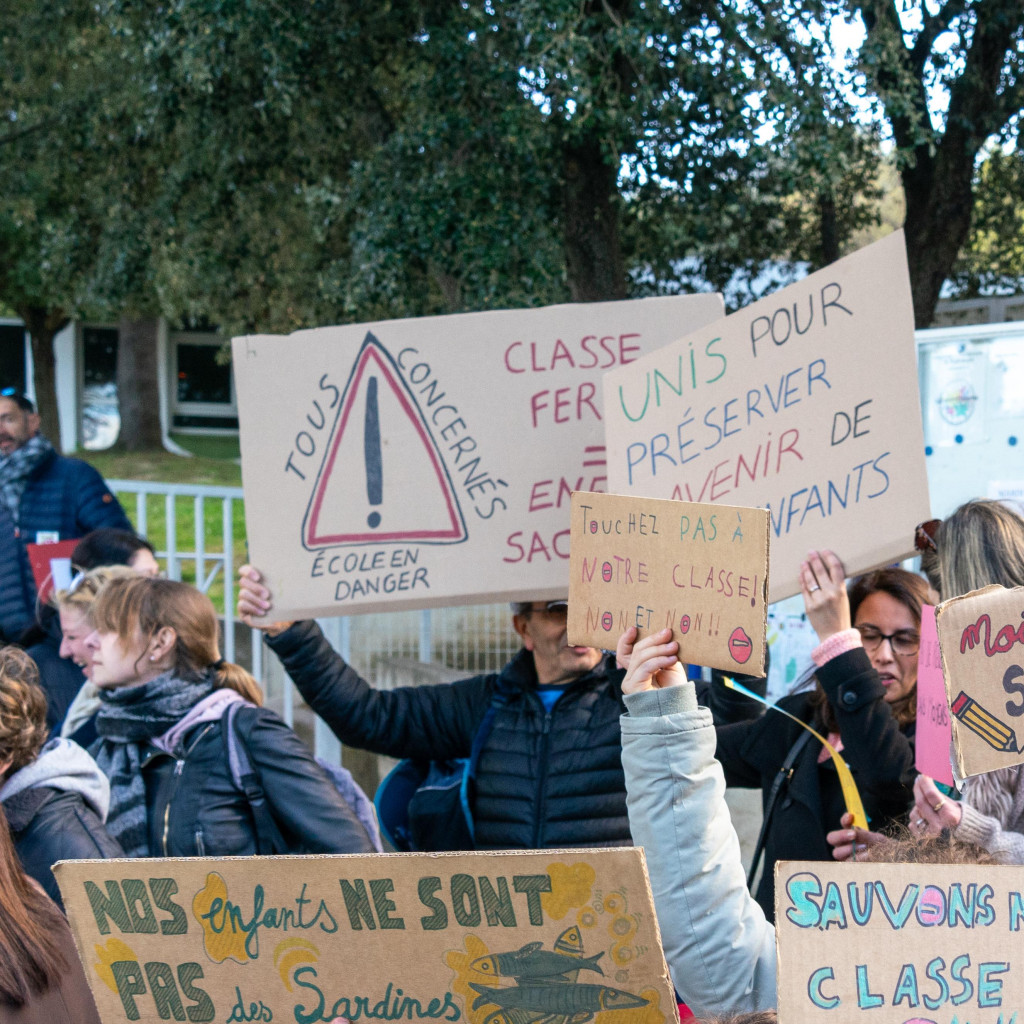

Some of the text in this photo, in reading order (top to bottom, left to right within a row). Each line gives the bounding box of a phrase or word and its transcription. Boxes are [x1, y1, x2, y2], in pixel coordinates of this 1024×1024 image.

[504, 333, 642, 374] CLASSE
[619, 282, 853, 422] UNIS POUR
[284, 373, 340, 481] TOUS
[397, 347, 509, 519] CONCERNÉS
[626, 358, 831, 486] PRÉSERVER
[831, 399, 873, 446] DE
[757, 452, 891, 538] NFANTS
[680, 515, 717, 542] PAS
[732, 512, 744, 543] À
[311, 548, 419, 578] ÉCOLE EN
[334, 567, 430, 601] DANGER
[581, 555, 757, 608] NOTRE CLASSE!
[586, 606, 629, 634] NON
[635, 605, 654, 630] ET
[83, 873, 553, 960] NOS enfants NE SONT
[785, 871, 996, 932] SAUVONS
[109, 960, 217, 1024] PAS
[807, 953, 1011, 1011] CLASSE
